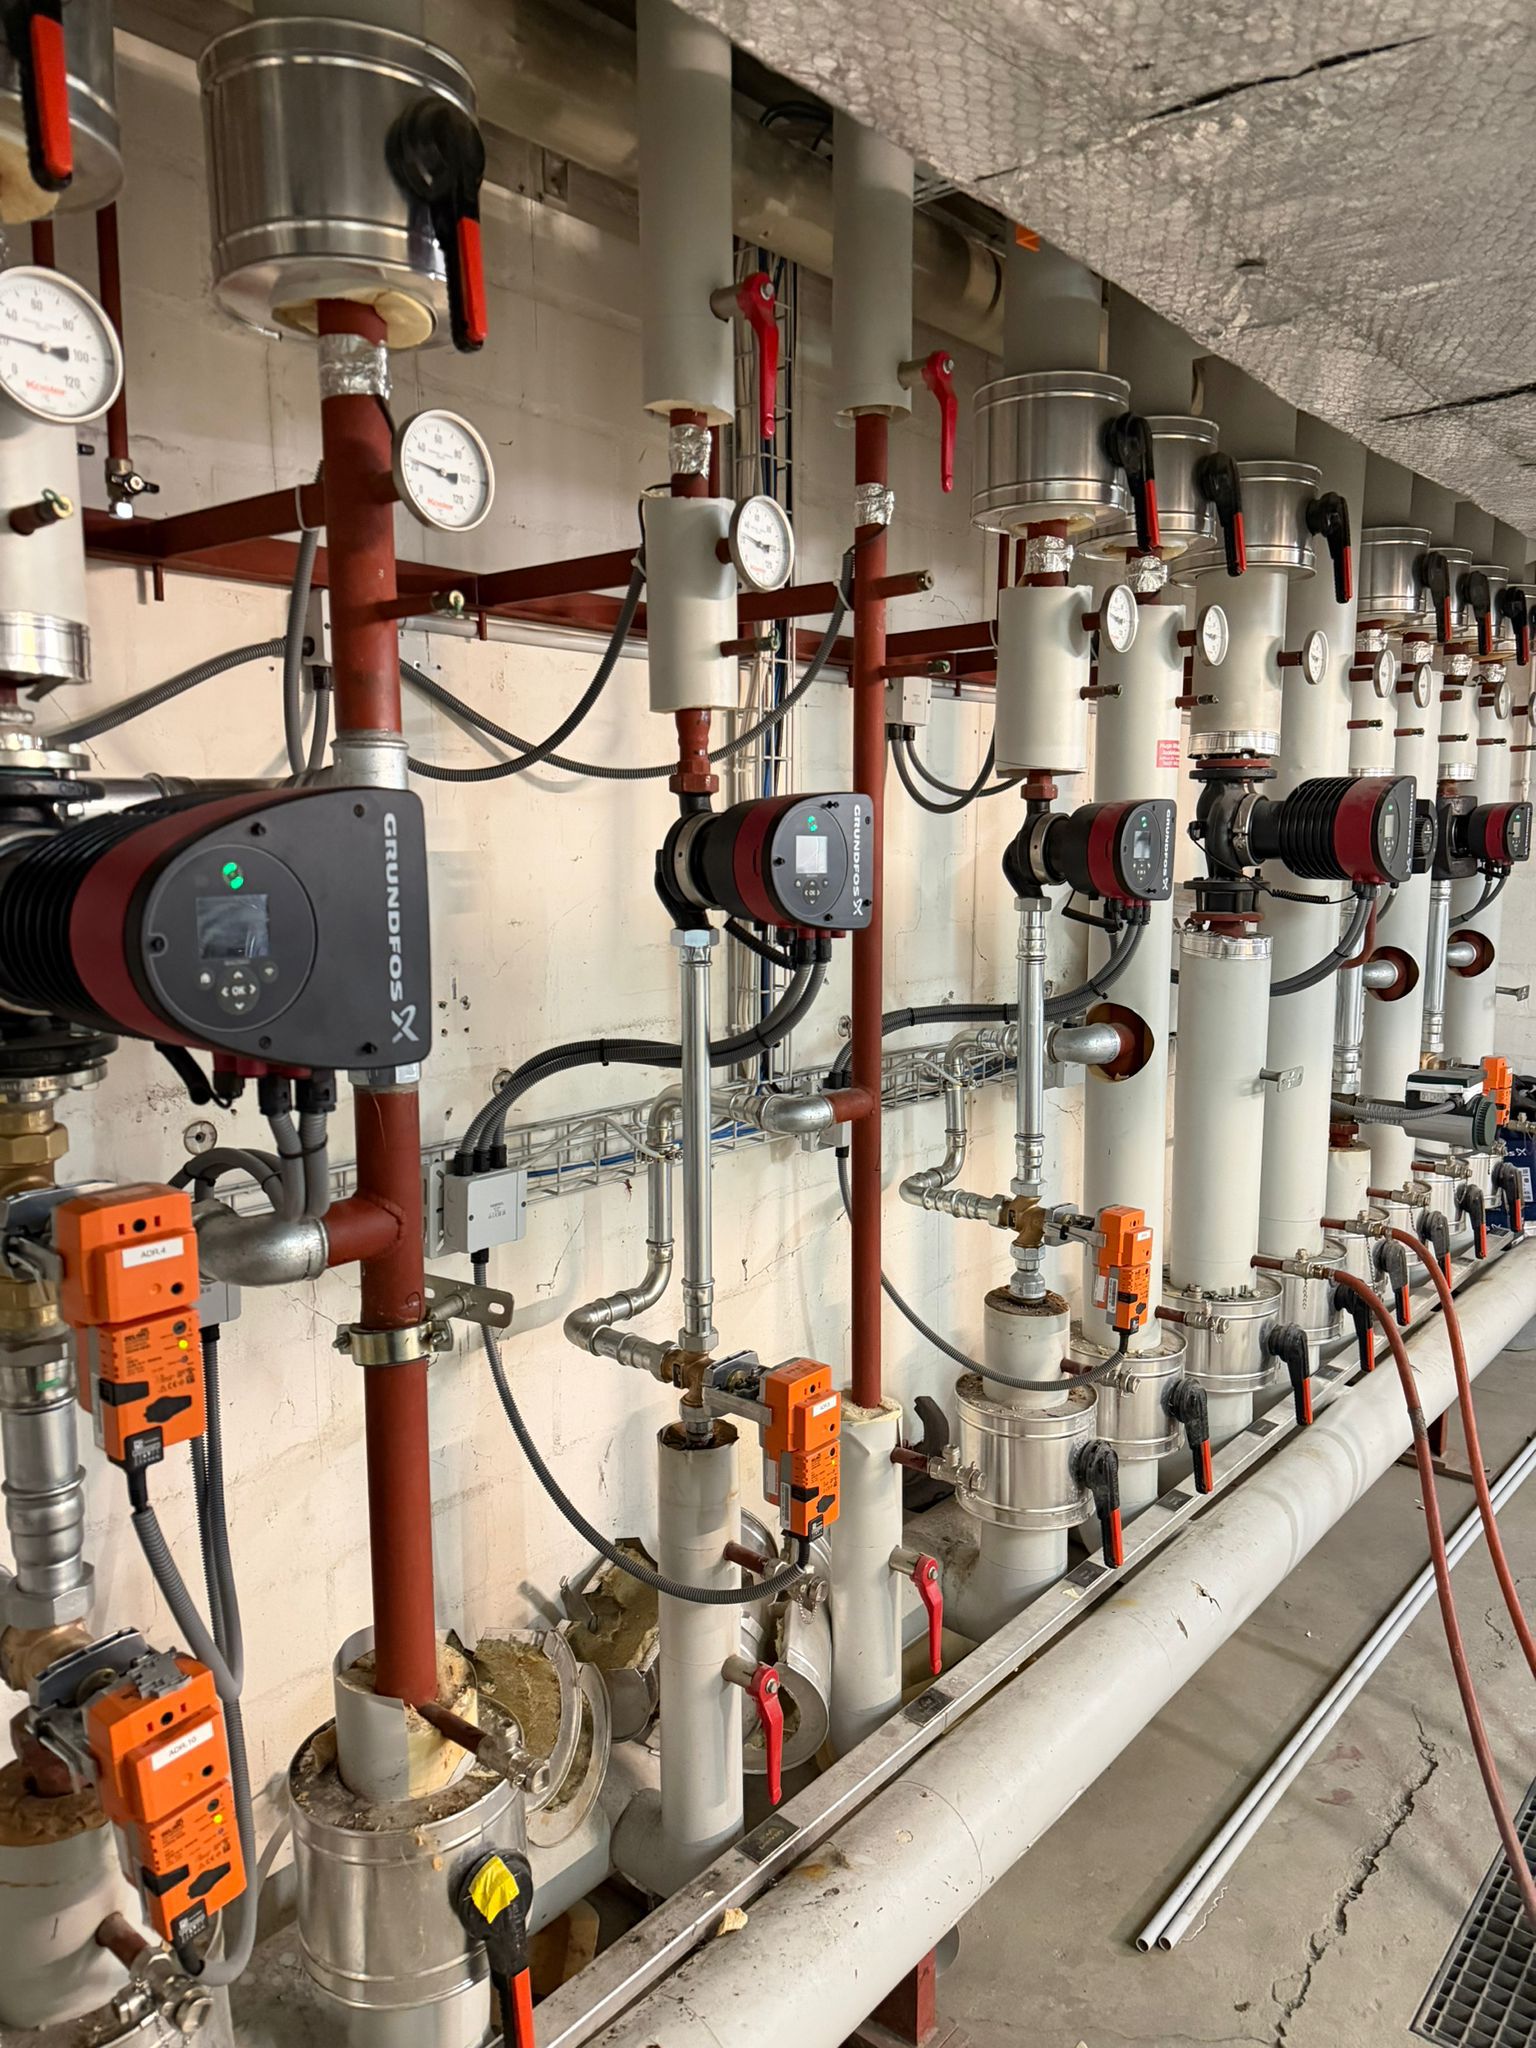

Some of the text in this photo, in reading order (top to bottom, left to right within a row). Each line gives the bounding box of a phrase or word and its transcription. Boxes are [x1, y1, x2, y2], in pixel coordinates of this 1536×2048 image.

[5, 307, 18, 321] 40
[73, 348, 90, 364] 100
[64, 375, 81, 390] 120
[853, 804, 861, 897] GRUNDFOS
[1163, 808, 1171, 877] GRUNDFOS
[384, 813, 403, 1002] GRUNDFOS
[231, 985, 247, 997] OK
